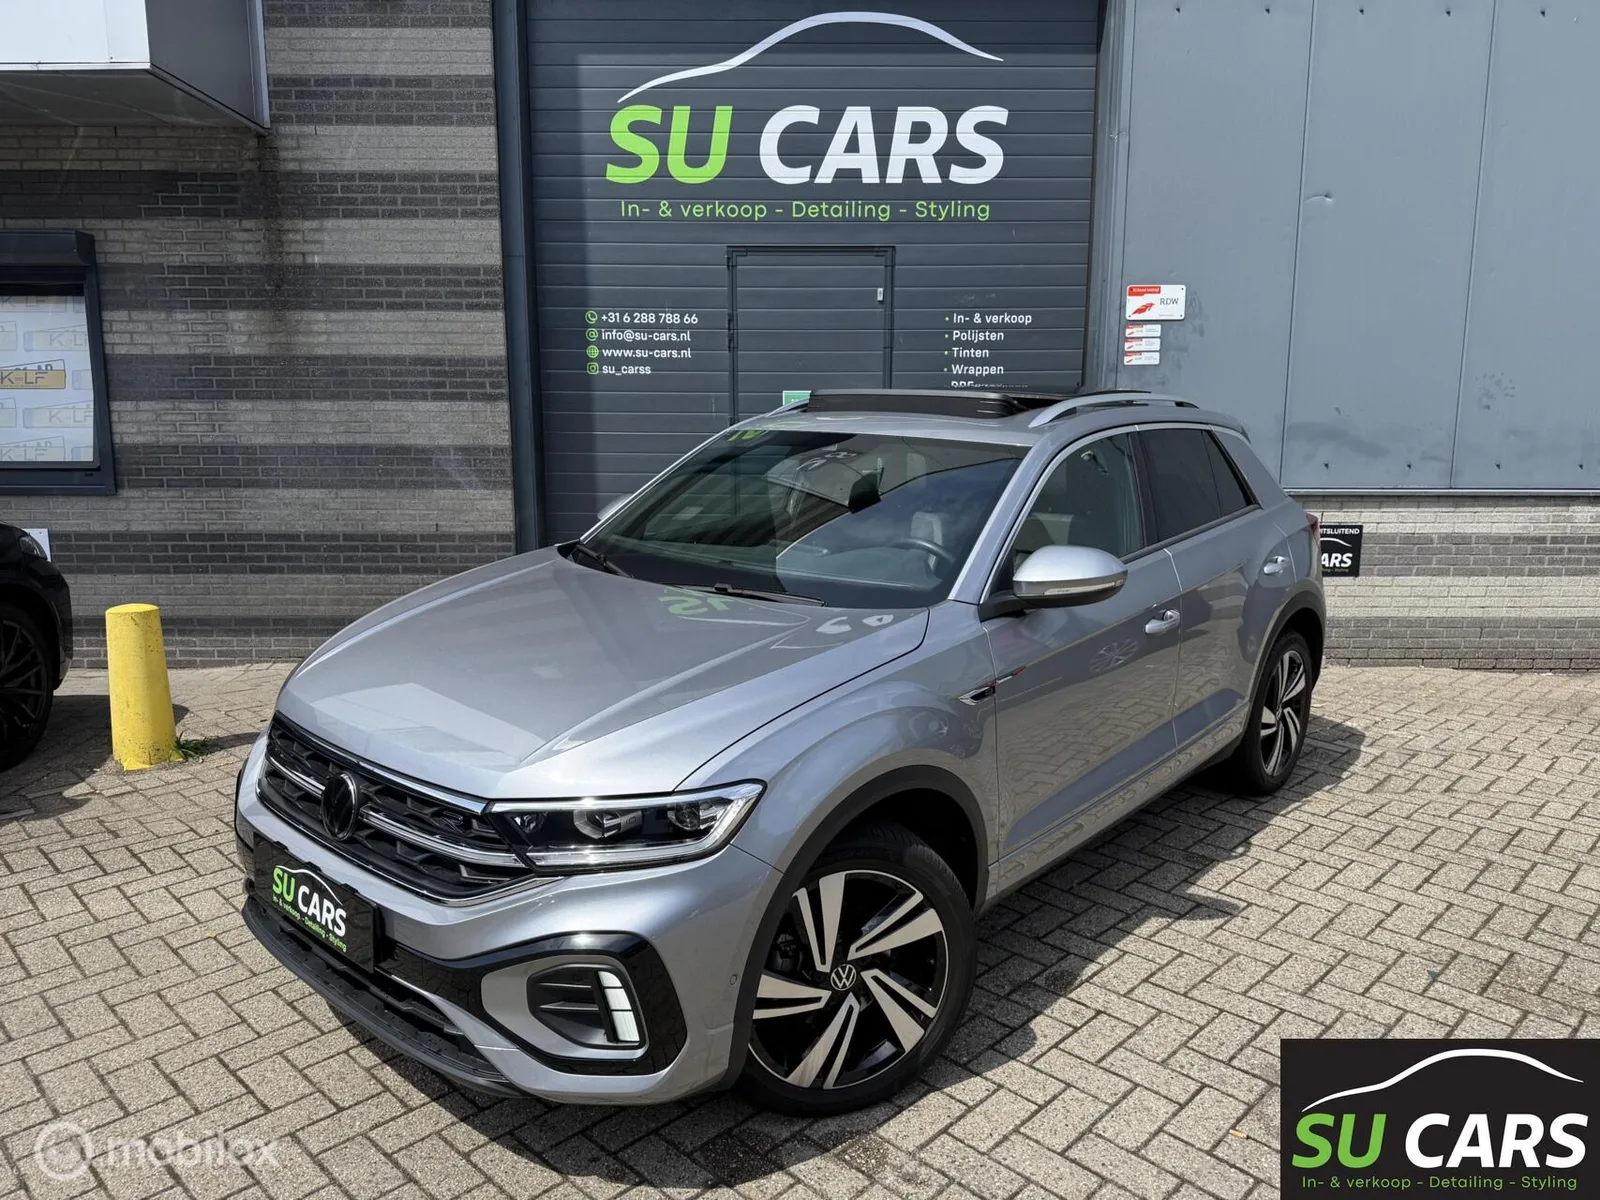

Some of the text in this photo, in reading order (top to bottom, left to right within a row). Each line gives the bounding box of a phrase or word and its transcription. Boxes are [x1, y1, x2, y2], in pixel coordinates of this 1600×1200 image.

[606, 105, 1009, 185] SU CARS
[620, 201, 650, 218] In-
[658, 201, 673, 218] &
[681, 201, 767, 220] verkoop
[792, 201, 891, 221] Detailing
[915, 201, 991, 221] Styling
[1159, 297, 1179, 306] RDW
[601, 312, 698, 324] +31 6 288 788 66
[953, 312, 1032, 326] In- & verkoop
[601, 329, 691, 342] info@su-cars.nl
[952, 330, 1004, 343] Polijsten
[602, 347, 692, 359] www.su-cars.nl
[951, 347, 989, 358] Tinten
[602, 364, 652, 376] su_carss
[951, 363, 1004, 377] Wrappen
[1321, 552, 1353, 568] ARS
[272, 866, 347, 938] SU CARS
